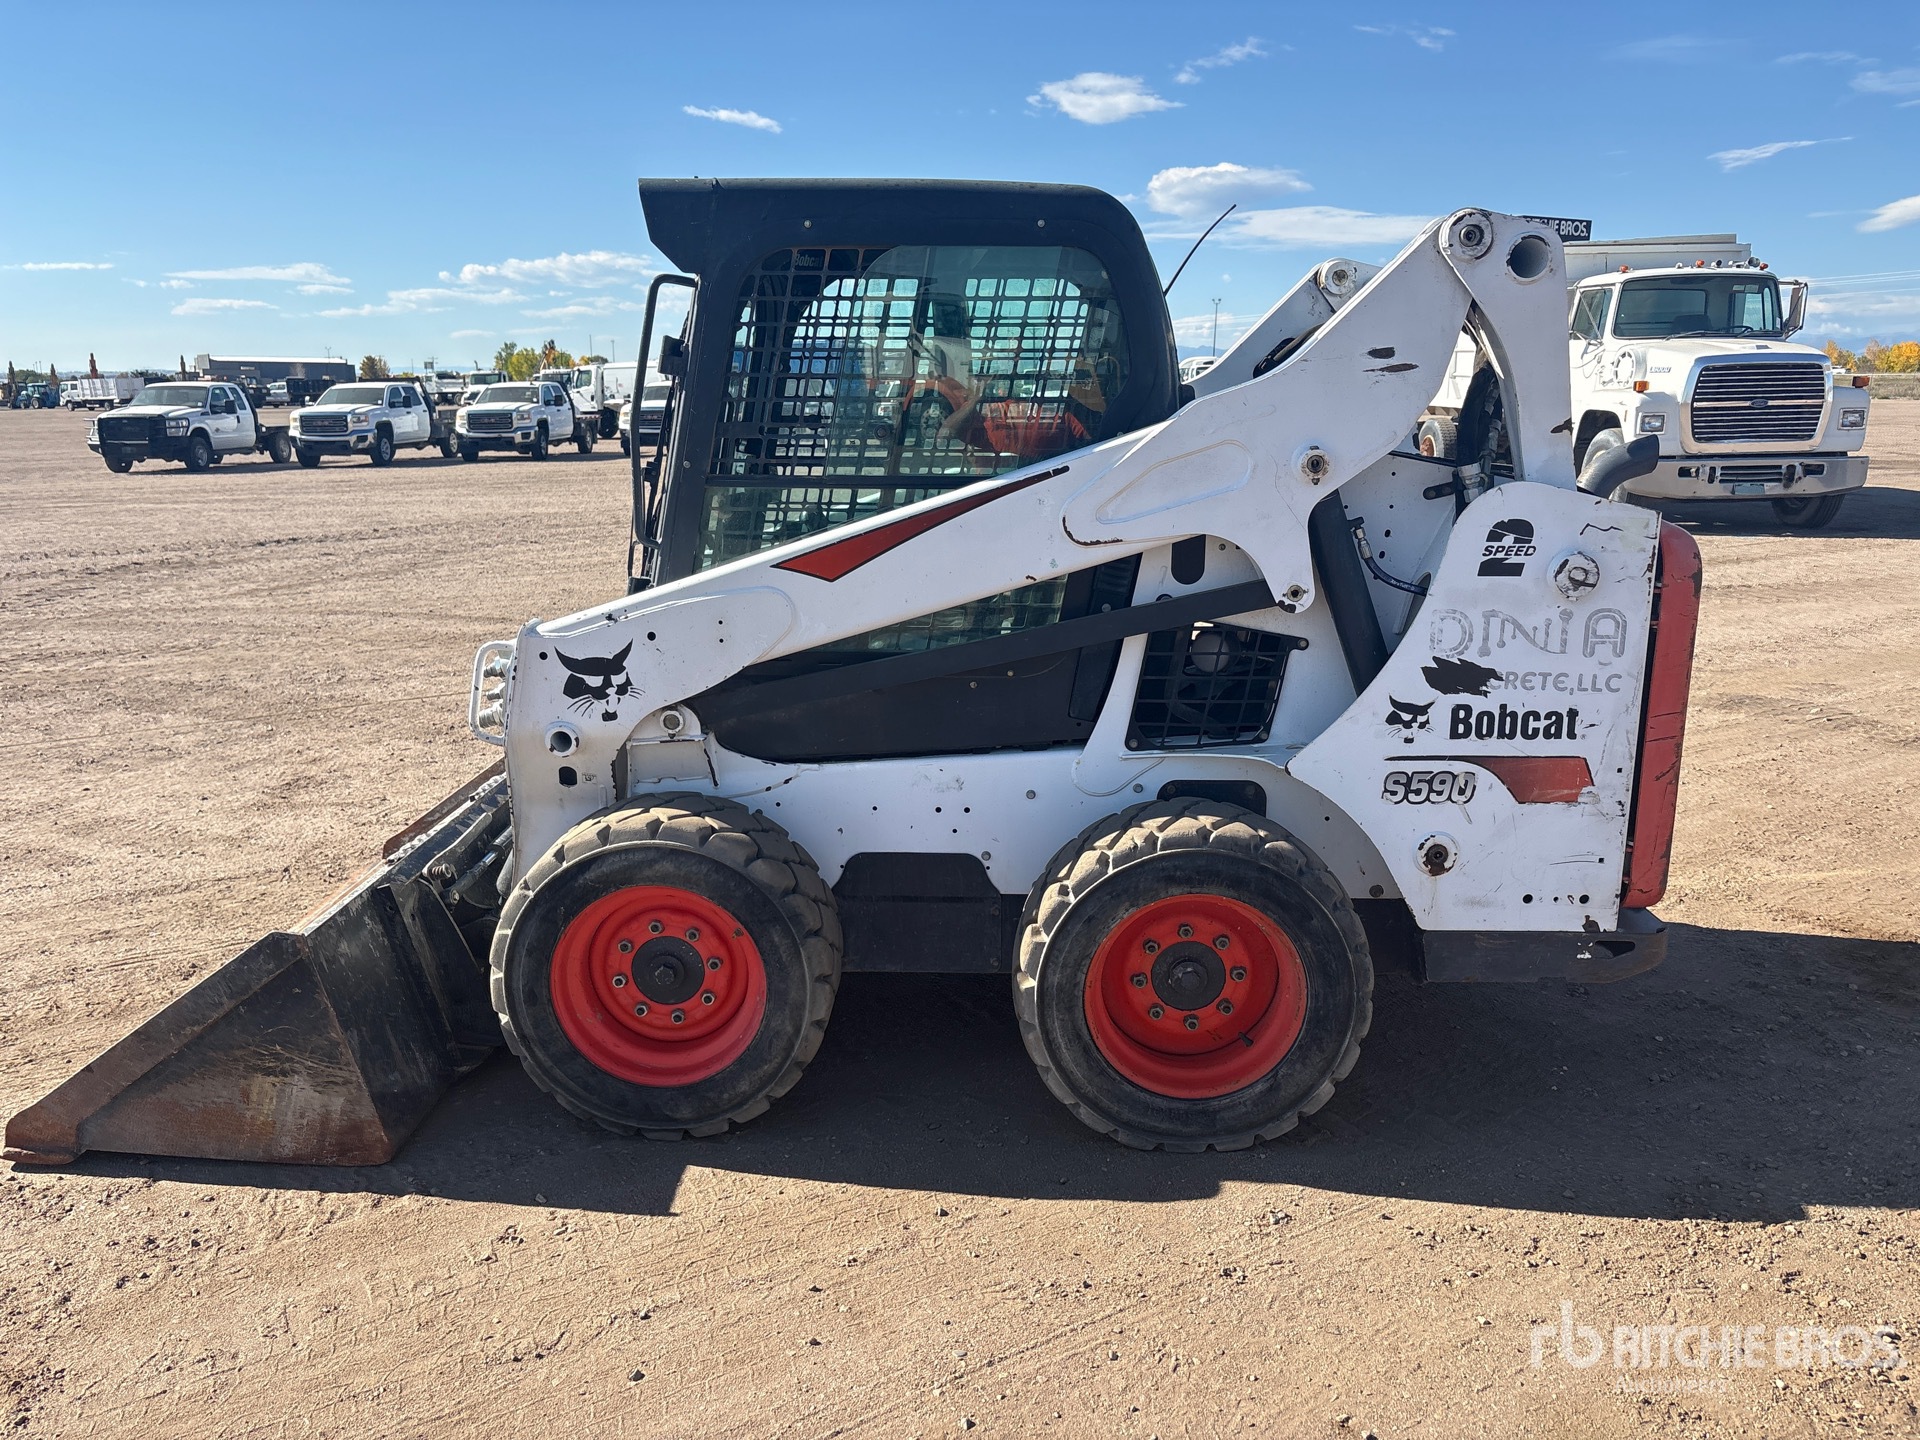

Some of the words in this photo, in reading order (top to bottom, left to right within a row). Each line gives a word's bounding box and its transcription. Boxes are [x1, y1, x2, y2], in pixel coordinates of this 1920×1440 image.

[1560, 220, 1588, 237] BROS.
[1477, 518, 1535, 577] 2
[1481, 544, 1537, 557] SPEED
[1450, 703, 1579, 740] Bobcat
[1381, 770, 1478, 805] S590
